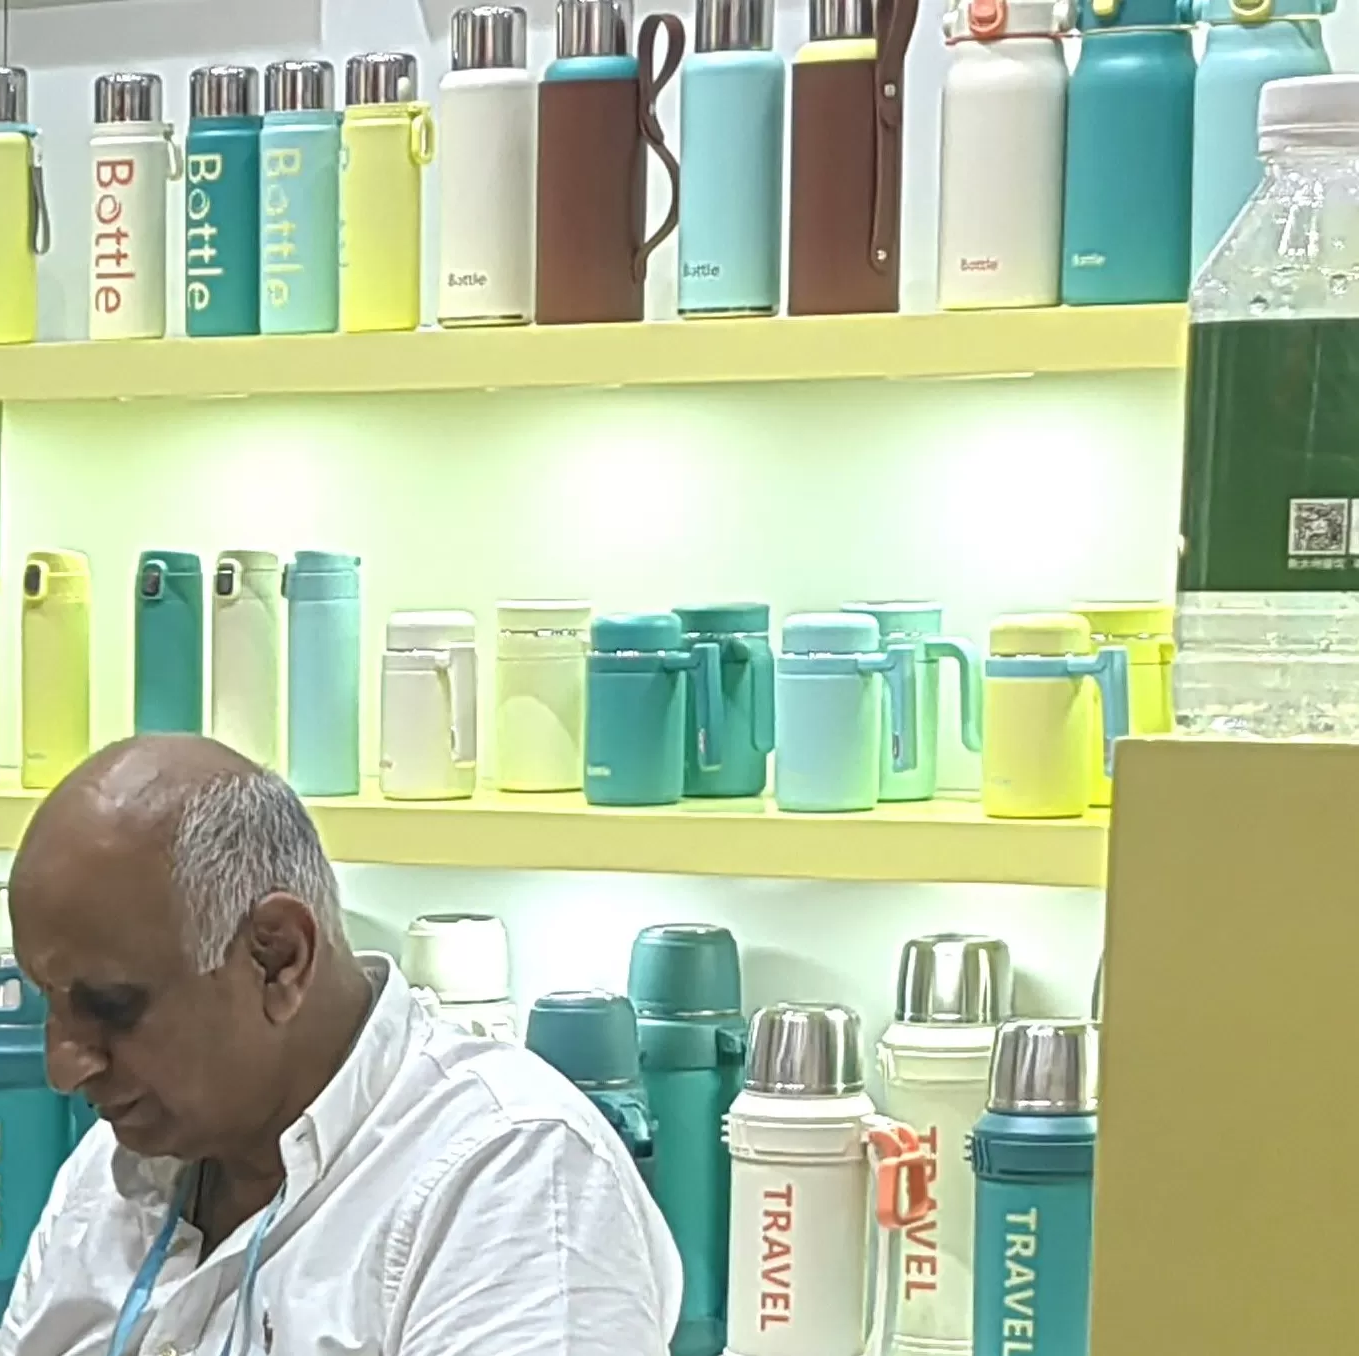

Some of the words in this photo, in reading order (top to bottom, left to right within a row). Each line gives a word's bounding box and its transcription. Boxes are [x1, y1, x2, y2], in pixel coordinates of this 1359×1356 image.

[94, 158, 135, 314] Bottle
[186, 153, 224, 311] Bottle
[266, 148, 304, 308] Bottle
[761, 1183, 793, 1332] TRAVEL
